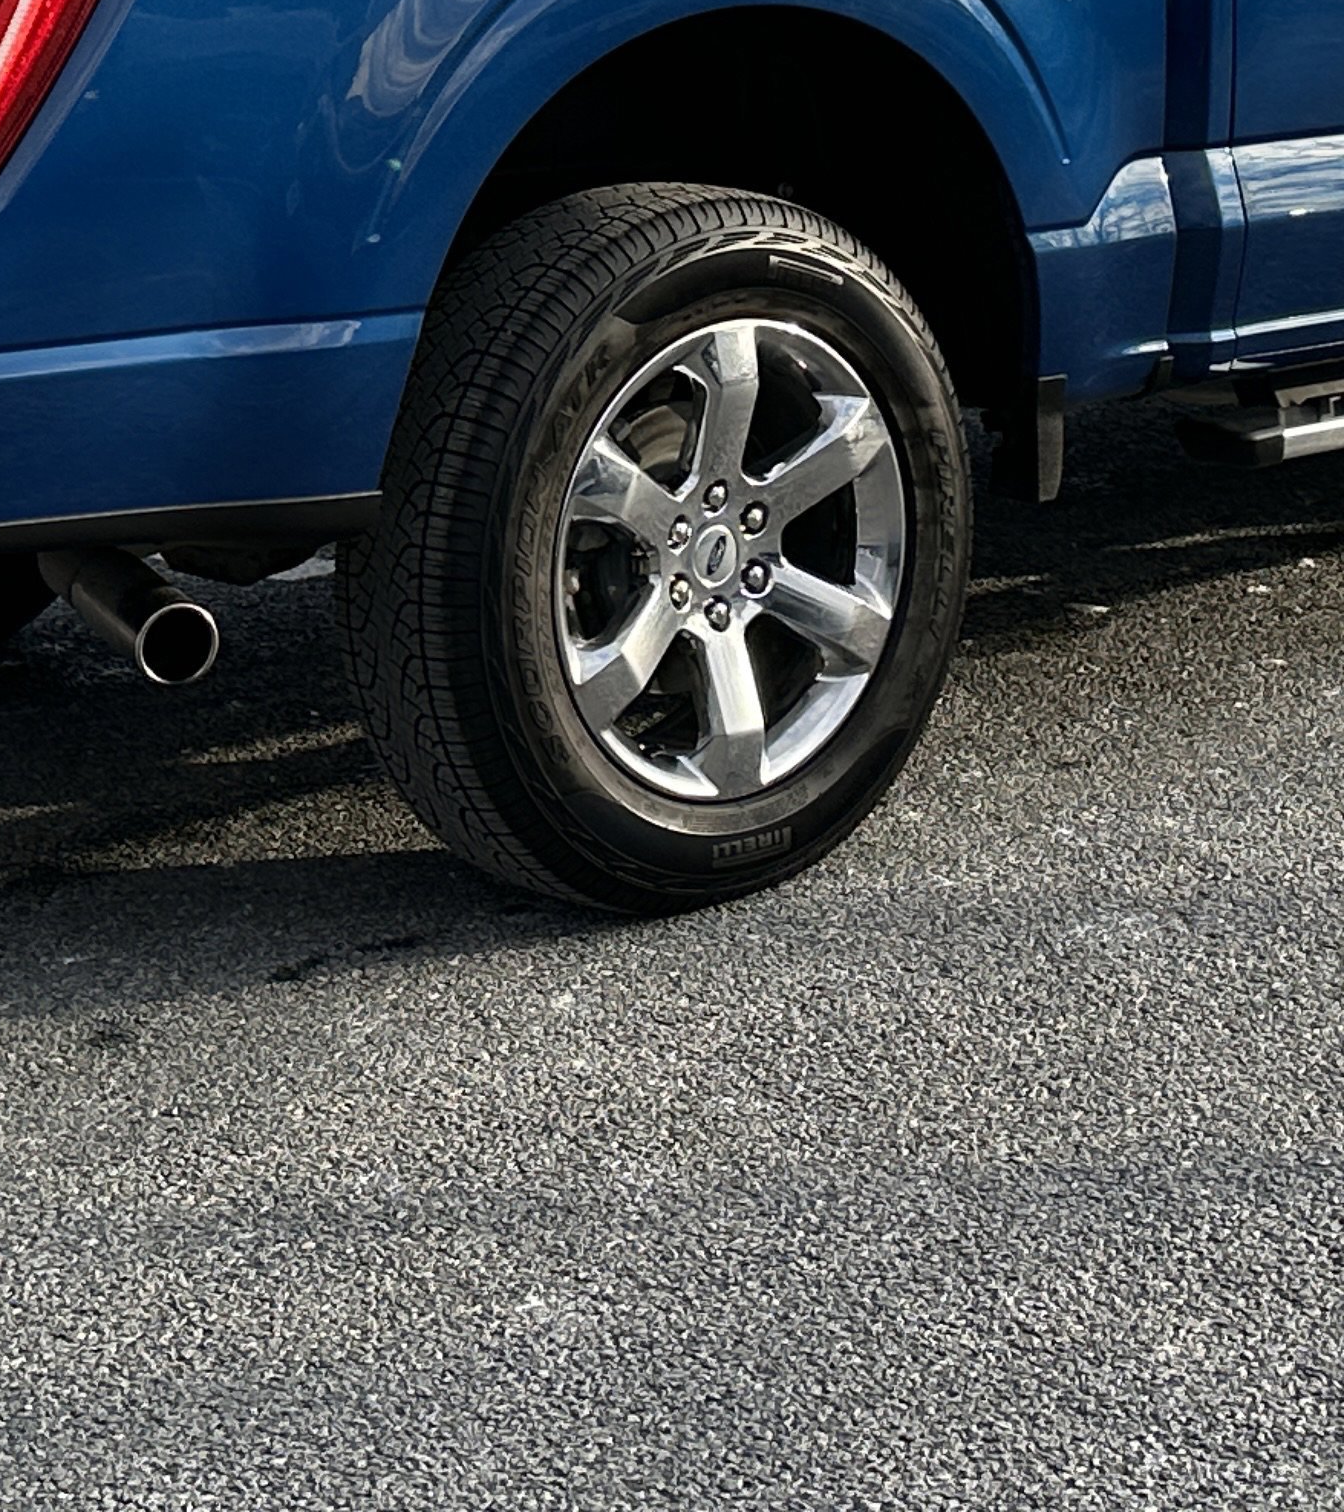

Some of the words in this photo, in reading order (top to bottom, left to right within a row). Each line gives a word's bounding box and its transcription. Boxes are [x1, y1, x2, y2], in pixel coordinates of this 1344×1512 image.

[513, 461, 570, 764] SCORPION
[929, 429, 955, 640] PIRELLI
[712, 826, 792, 868] PIRELLI
